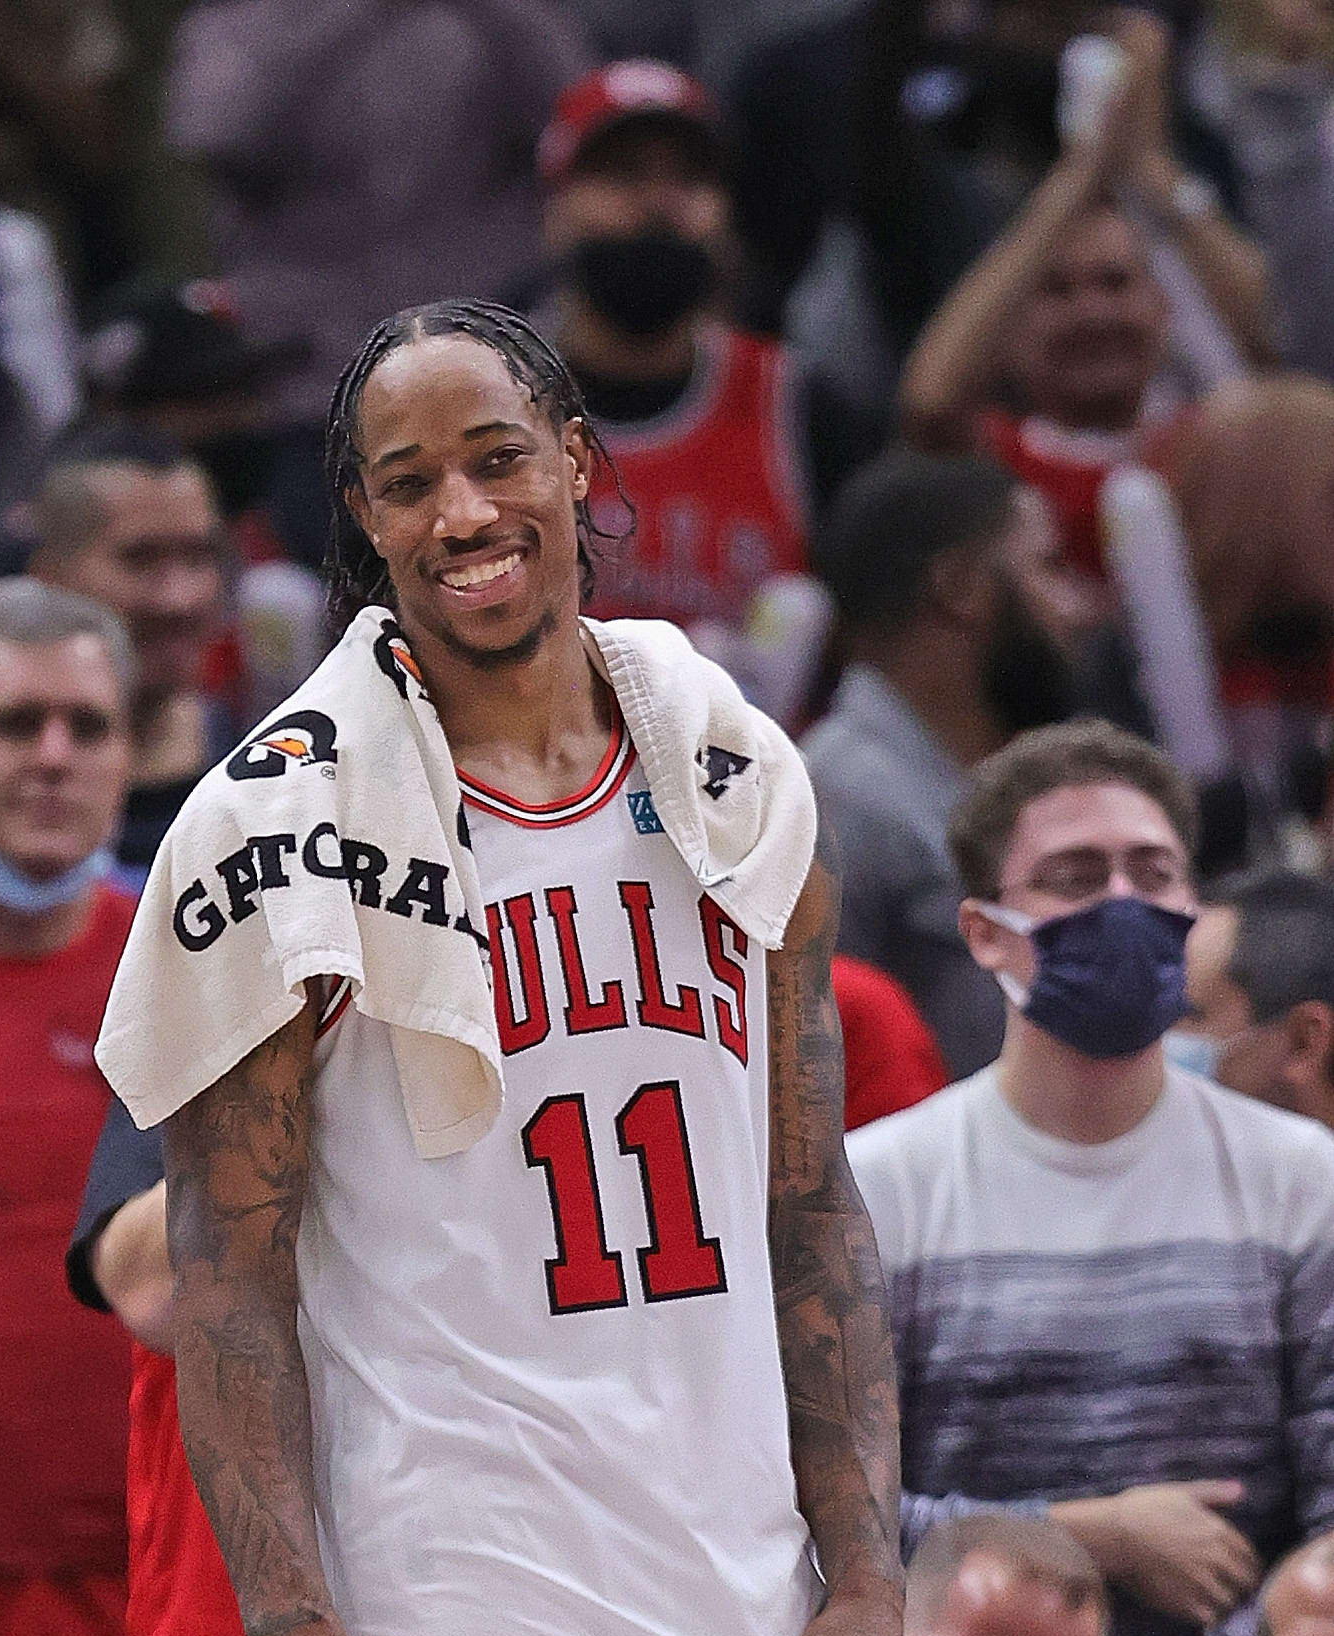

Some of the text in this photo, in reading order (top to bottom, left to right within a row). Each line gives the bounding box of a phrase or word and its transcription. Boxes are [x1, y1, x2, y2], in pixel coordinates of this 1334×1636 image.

[172, 822, 490, 952] GATORA
[484, 880, 750, 1070] ULLS
[520, 1079, 729, 1317] 11
